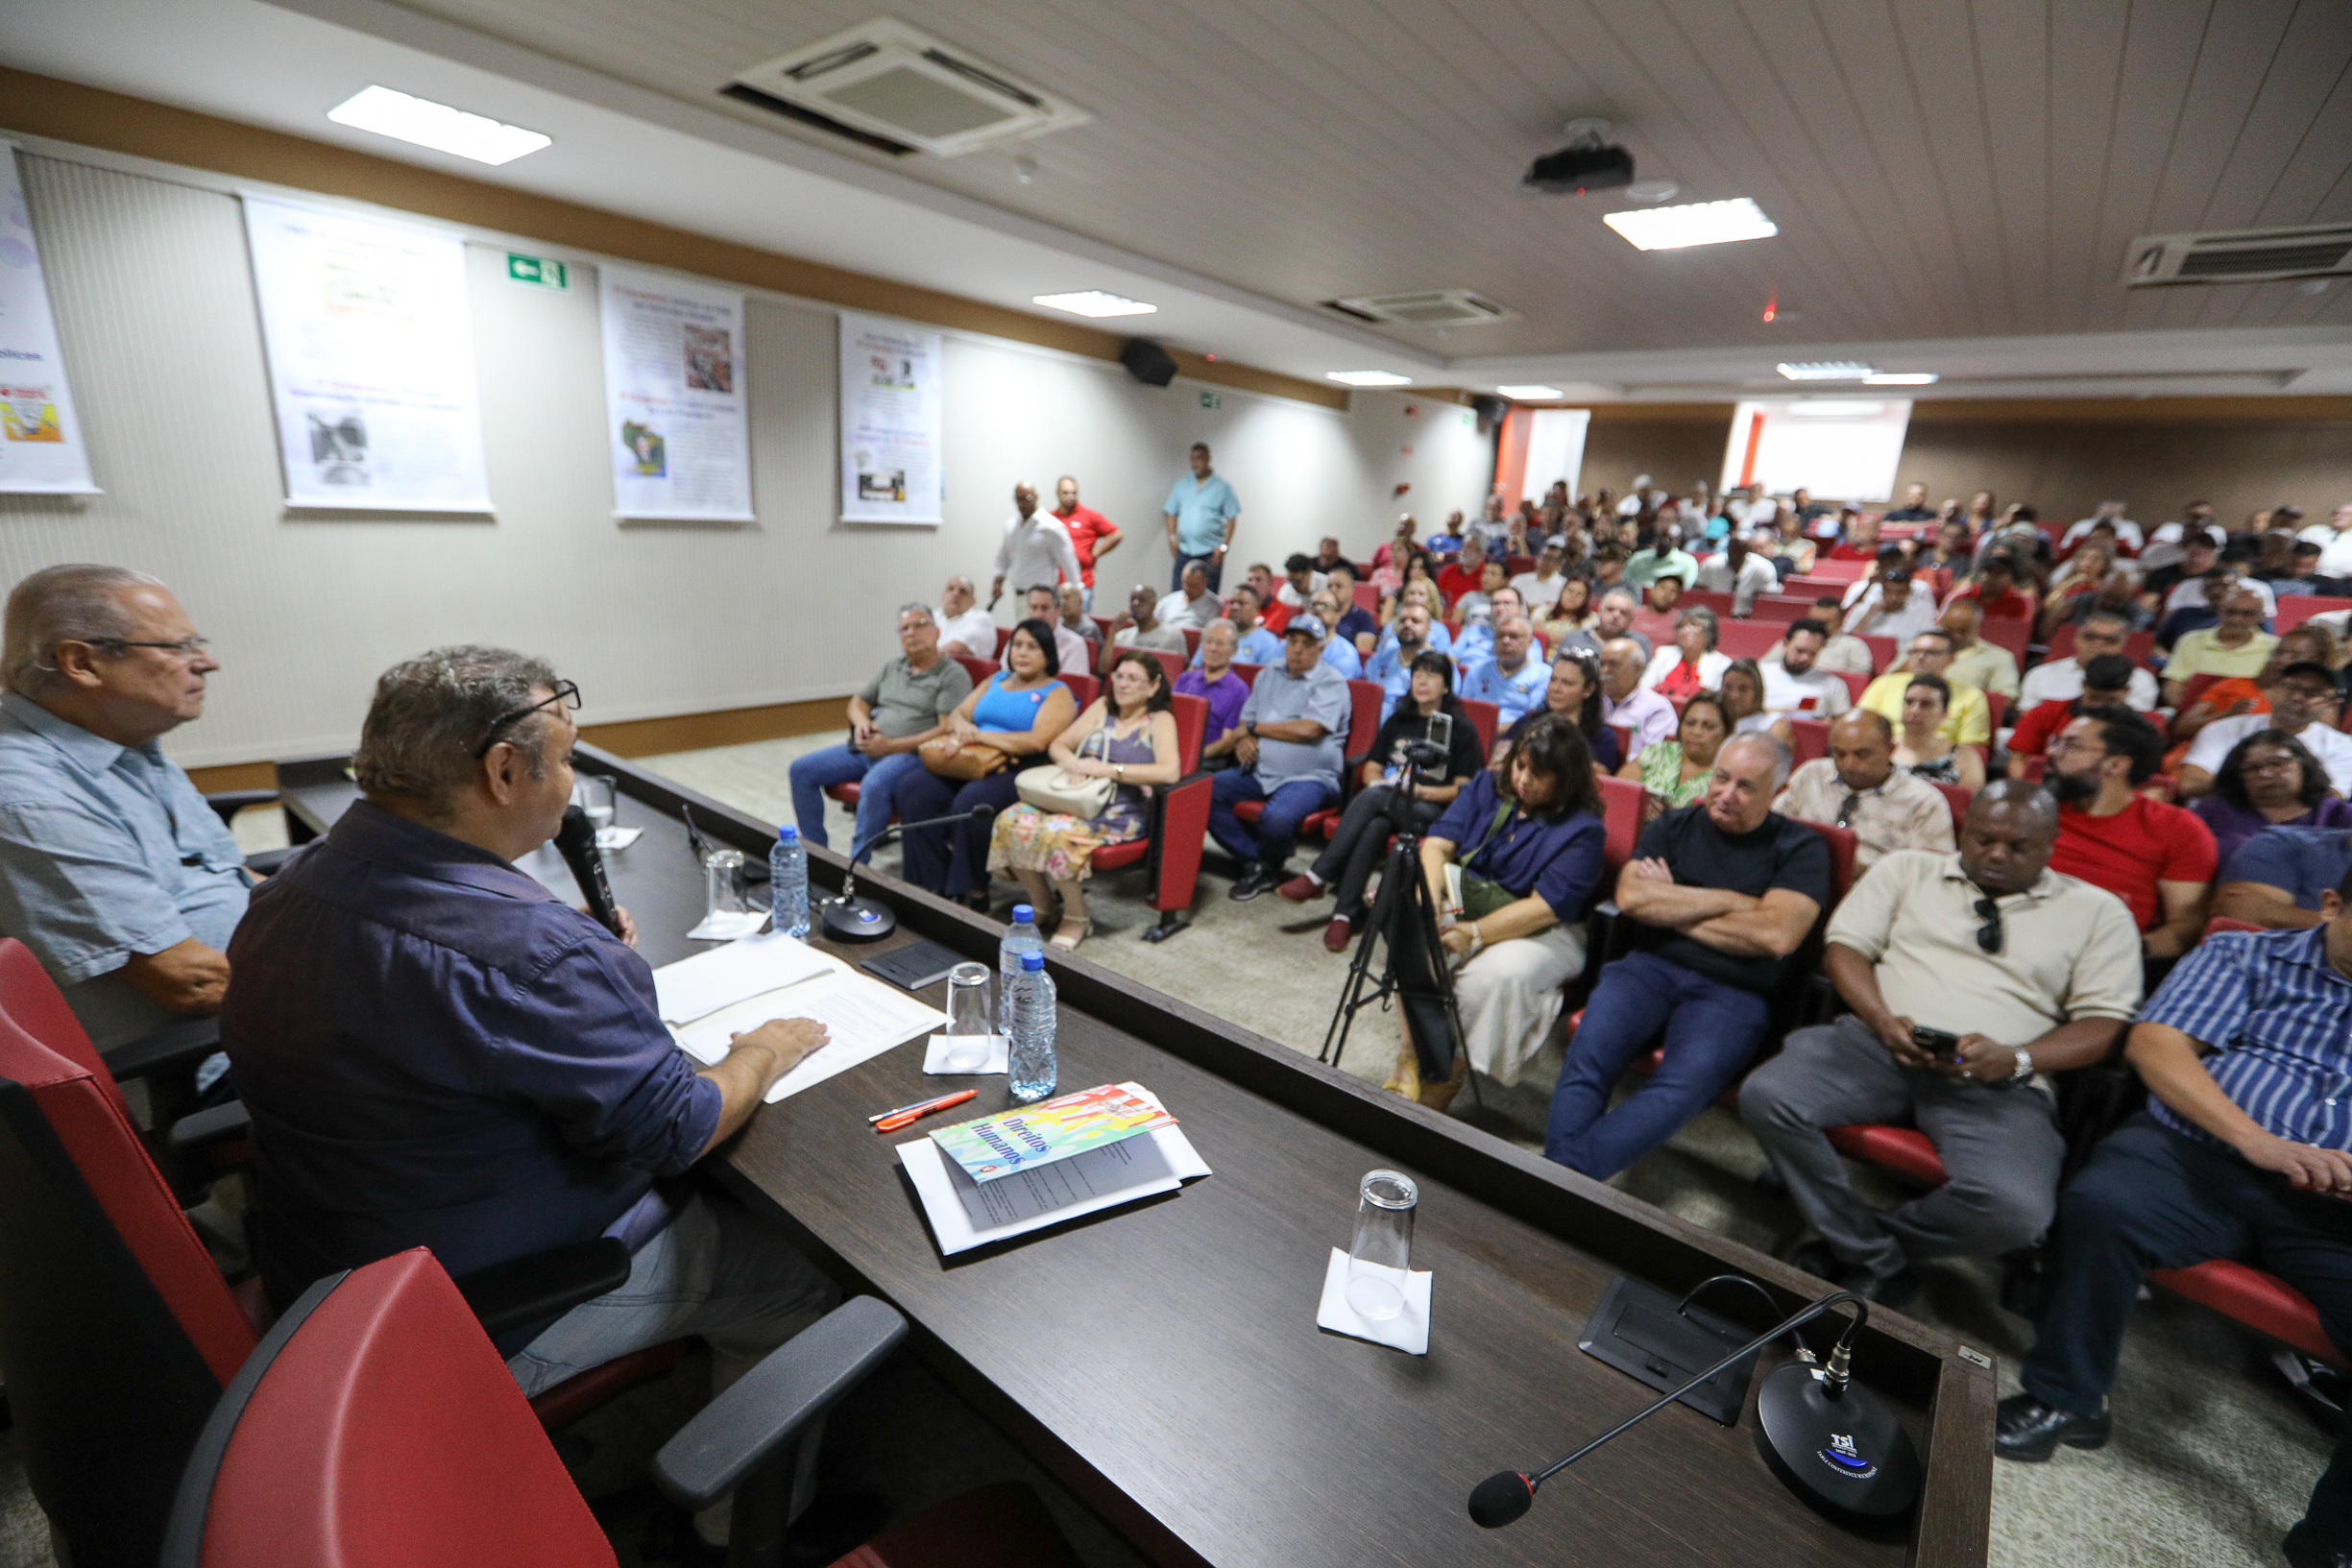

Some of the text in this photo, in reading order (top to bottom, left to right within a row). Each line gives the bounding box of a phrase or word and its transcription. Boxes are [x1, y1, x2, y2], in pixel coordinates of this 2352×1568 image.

[970, 1122, 1027, 1165] Humanos
[1003, 1119, 1052, 1152] Direitos
[1816, 1451, 1829, 1464] TABLE
[1828, 1461, 1857, 1478] CONFERENCE
